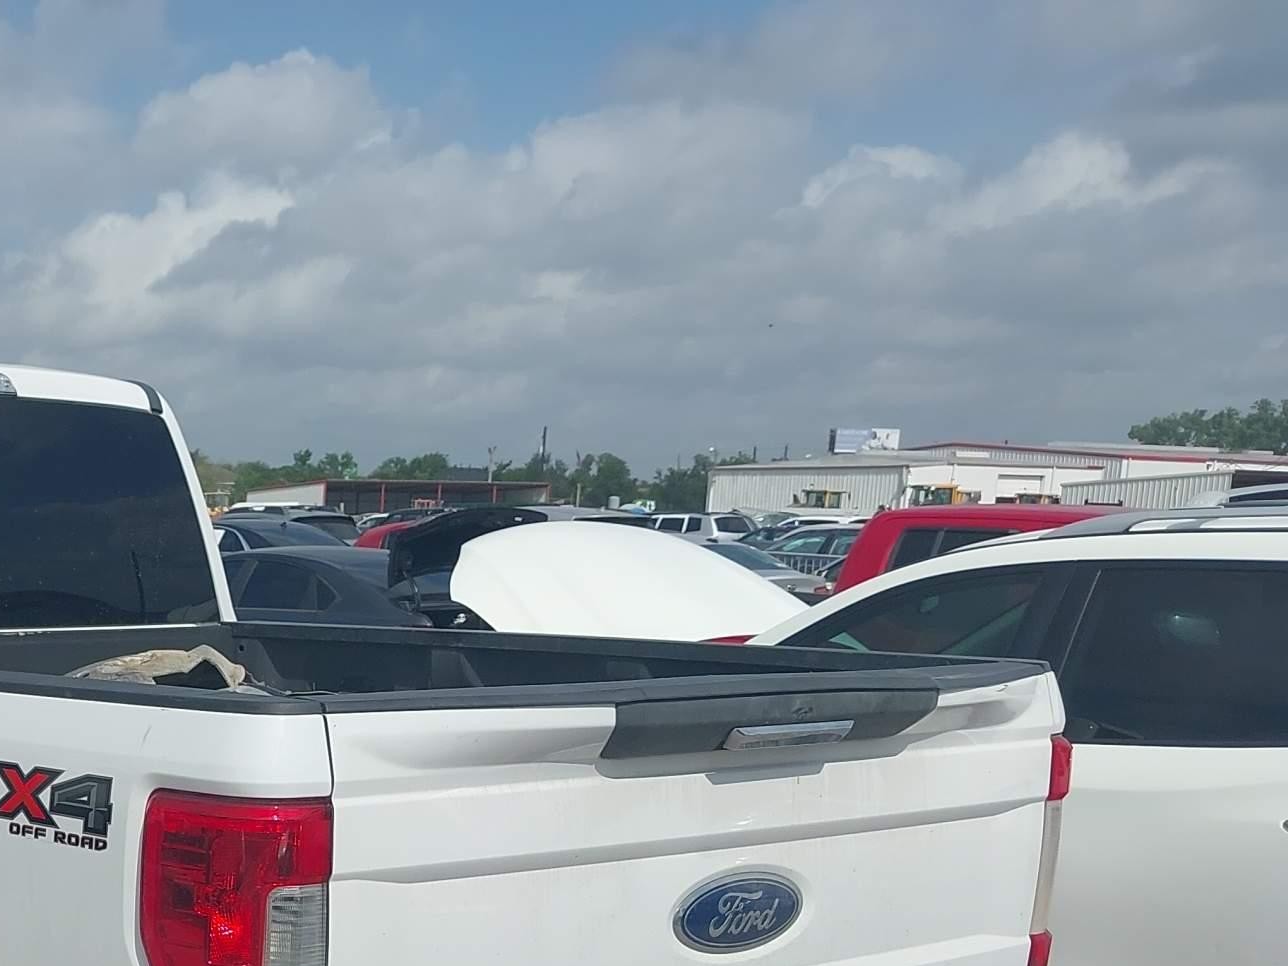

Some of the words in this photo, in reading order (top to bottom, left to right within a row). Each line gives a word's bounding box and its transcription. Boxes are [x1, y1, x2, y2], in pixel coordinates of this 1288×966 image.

[8, 822, 47, 840] OFF
[53, 830, 109, 852] ROAD
[708, 890, 780, 938] Ford
